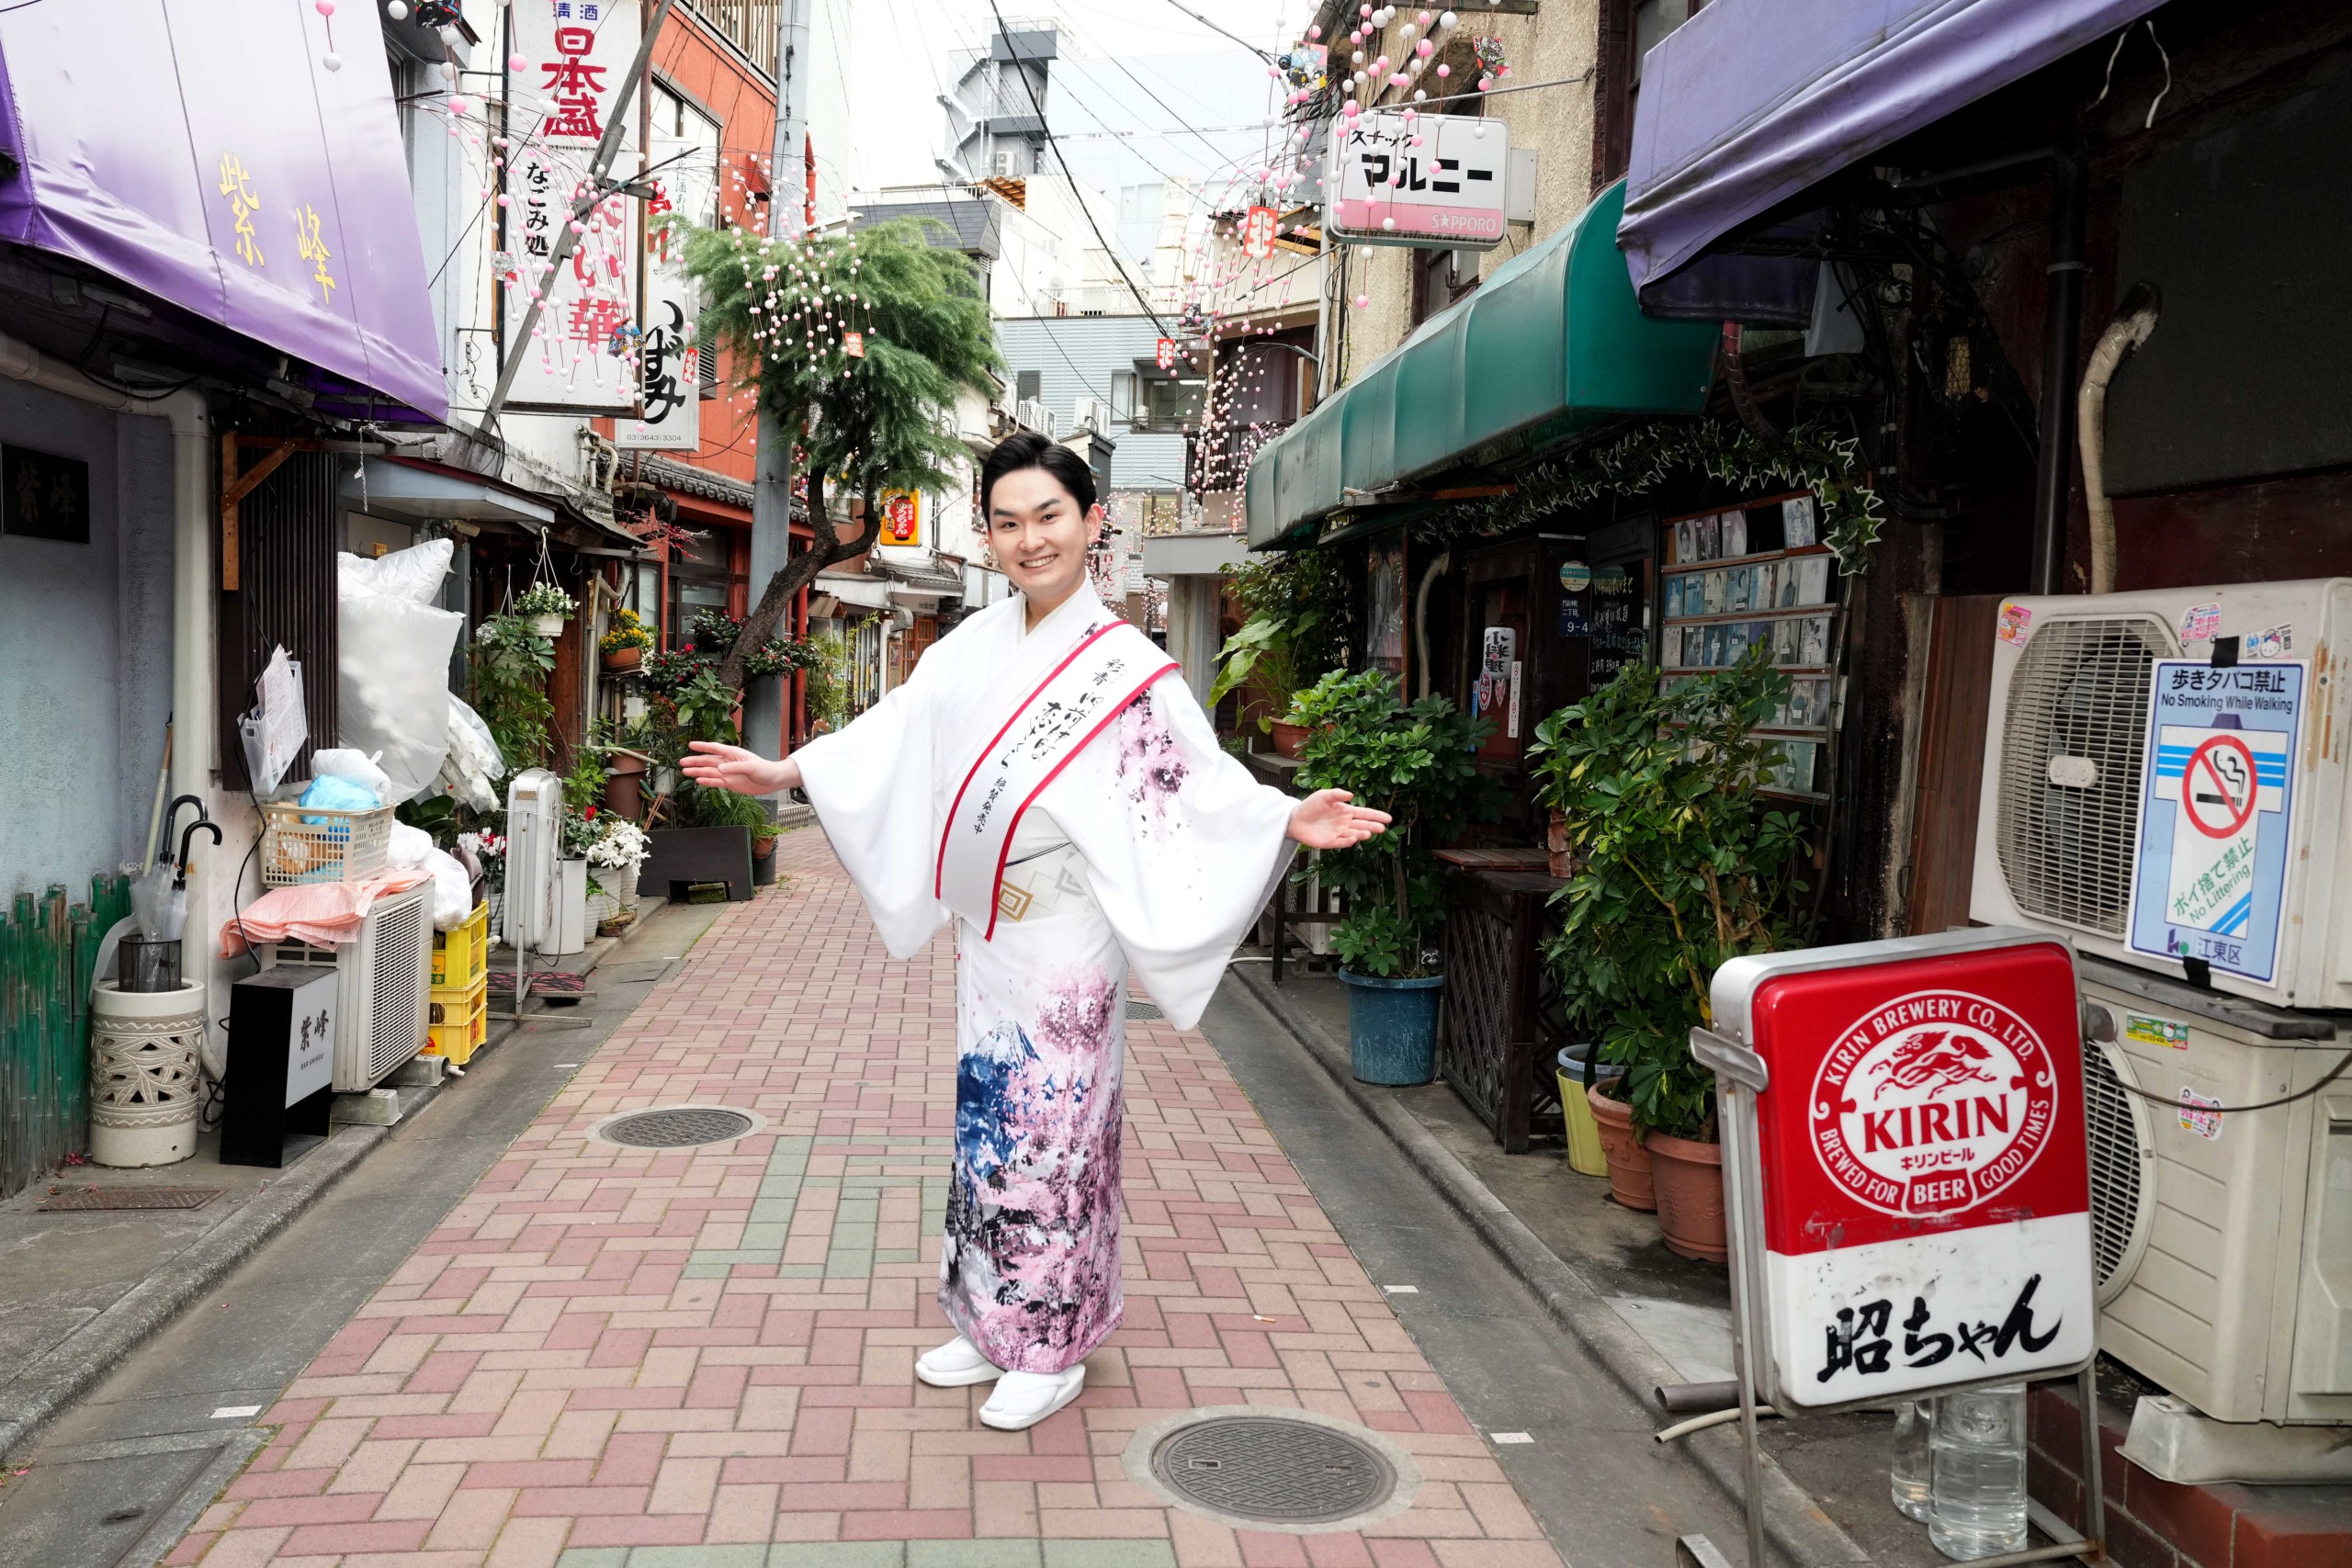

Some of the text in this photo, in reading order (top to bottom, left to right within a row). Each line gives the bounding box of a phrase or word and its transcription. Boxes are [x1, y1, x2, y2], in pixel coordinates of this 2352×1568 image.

[540, 27, 607, 141] 日本盛
[1350, 130, 1419, 148] スナック
[1362, 152, 1493, 193] マルニー
[218, 149, 336, 307] 紫峰
[526, 162, 549, 256] なごみ処
[1567, 621, 1589, 633] 9-4
[2161, 694, 2293, 715] No Smoking While Walking
[2172, 669, 2286, 694] 歩きタバコ禁止
[974, 777, 1007, 835] 絶賛発売中
[2173, 836, 2254, 917] ポイ捨て禁止
[2189, 863, 2251, 924] No Littering
[2198, 937, 2243, 965] 江東区
[1825, 1030, 1871, 1086] KIRIN
[1872, 998, 1962, 1036] BREWERY
[2002, 1023, 2035, 1062] LTD.
[1819, 1100, 2050, 1205] BREWED FOR BEER GOOD TIMES
[1862, 1093, 2009, 1154] KIRIN
[1900, 1147, 1975, 1170] キリンビール
[1816, 1273, 2064, 1382] 昭ちゃん
